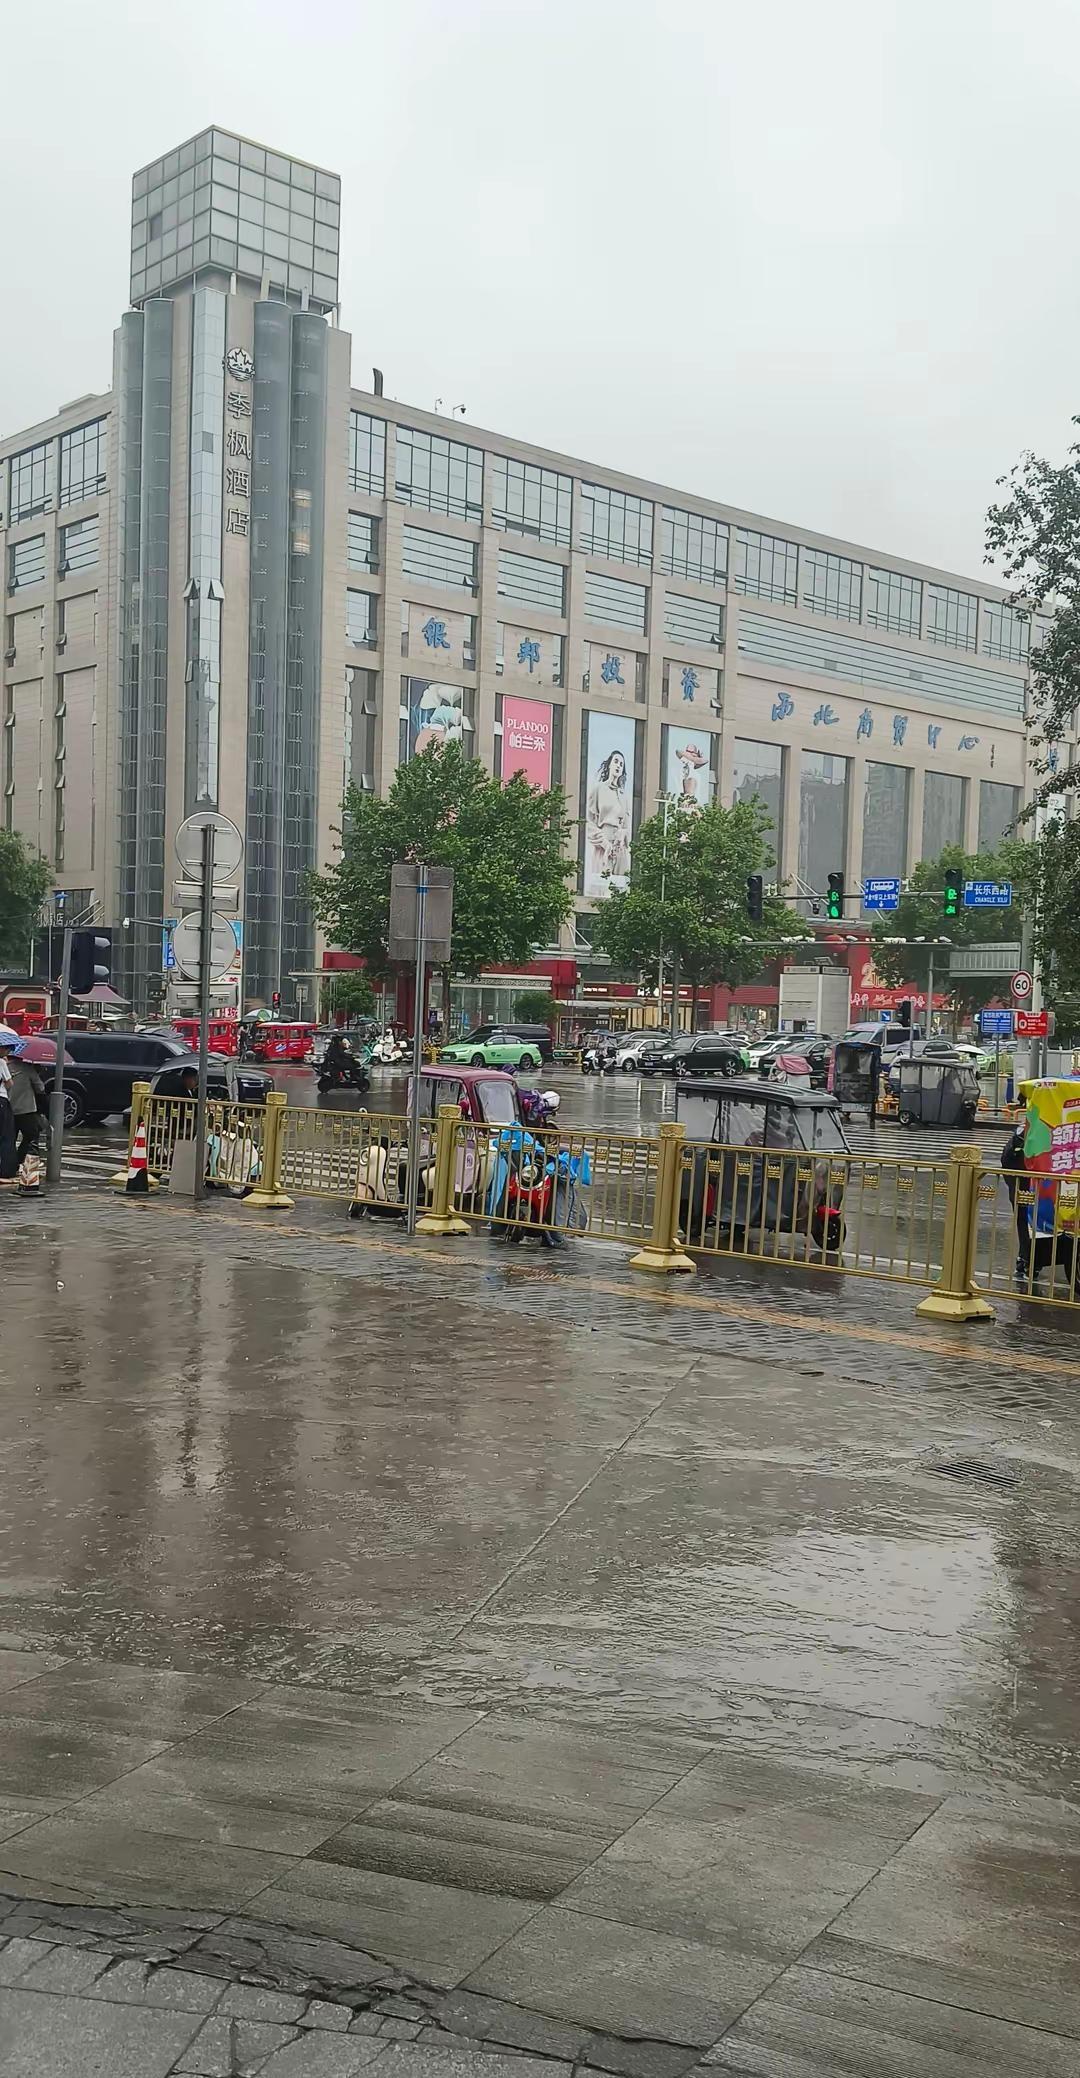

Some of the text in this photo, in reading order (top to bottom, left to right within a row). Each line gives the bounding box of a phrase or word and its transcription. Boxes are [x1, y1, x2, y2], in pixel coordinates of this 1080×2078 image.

[227, 391, 251, 536] 季枫酒店
[507, 718, 549, 735] PLANDOO
[508, 731, 546, 752] 帕兰朵
[974, 883, 1009, 896] 长乐西路
[1015, 980, 1028, 991] 60
